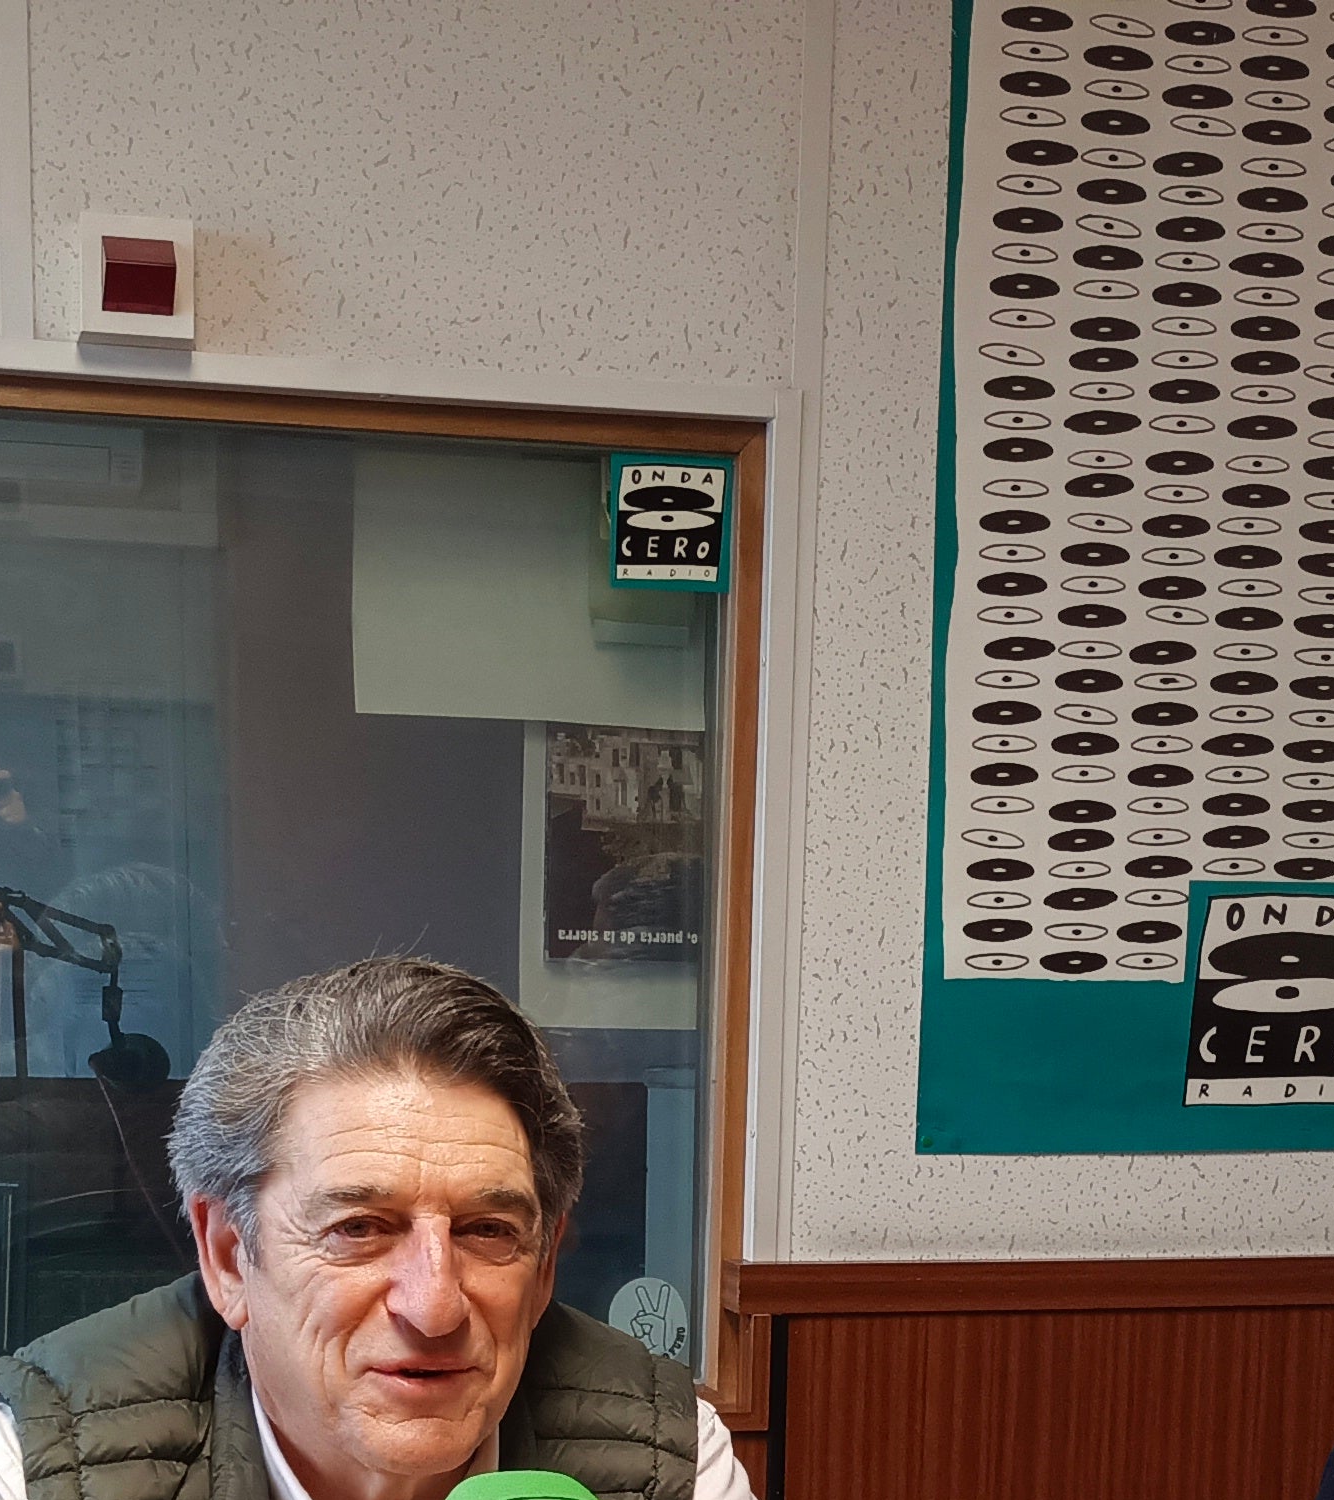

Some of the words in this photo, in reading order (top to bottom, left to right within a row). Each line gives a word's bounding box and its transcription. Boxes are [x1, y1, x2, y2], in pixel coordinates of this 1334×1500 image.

[631, 469, 713, 485] ONDA
[621, 536, 710, 559] CERO
[622, 568, 710, 577] RADIO
[558, 929, 598, 943] sierra
[603, 930, 615, 944] la
[620, 930, 636, 944] de
[640, 930, 683, 945] puerta
[668, 1327, 685, 1356] FUMO
